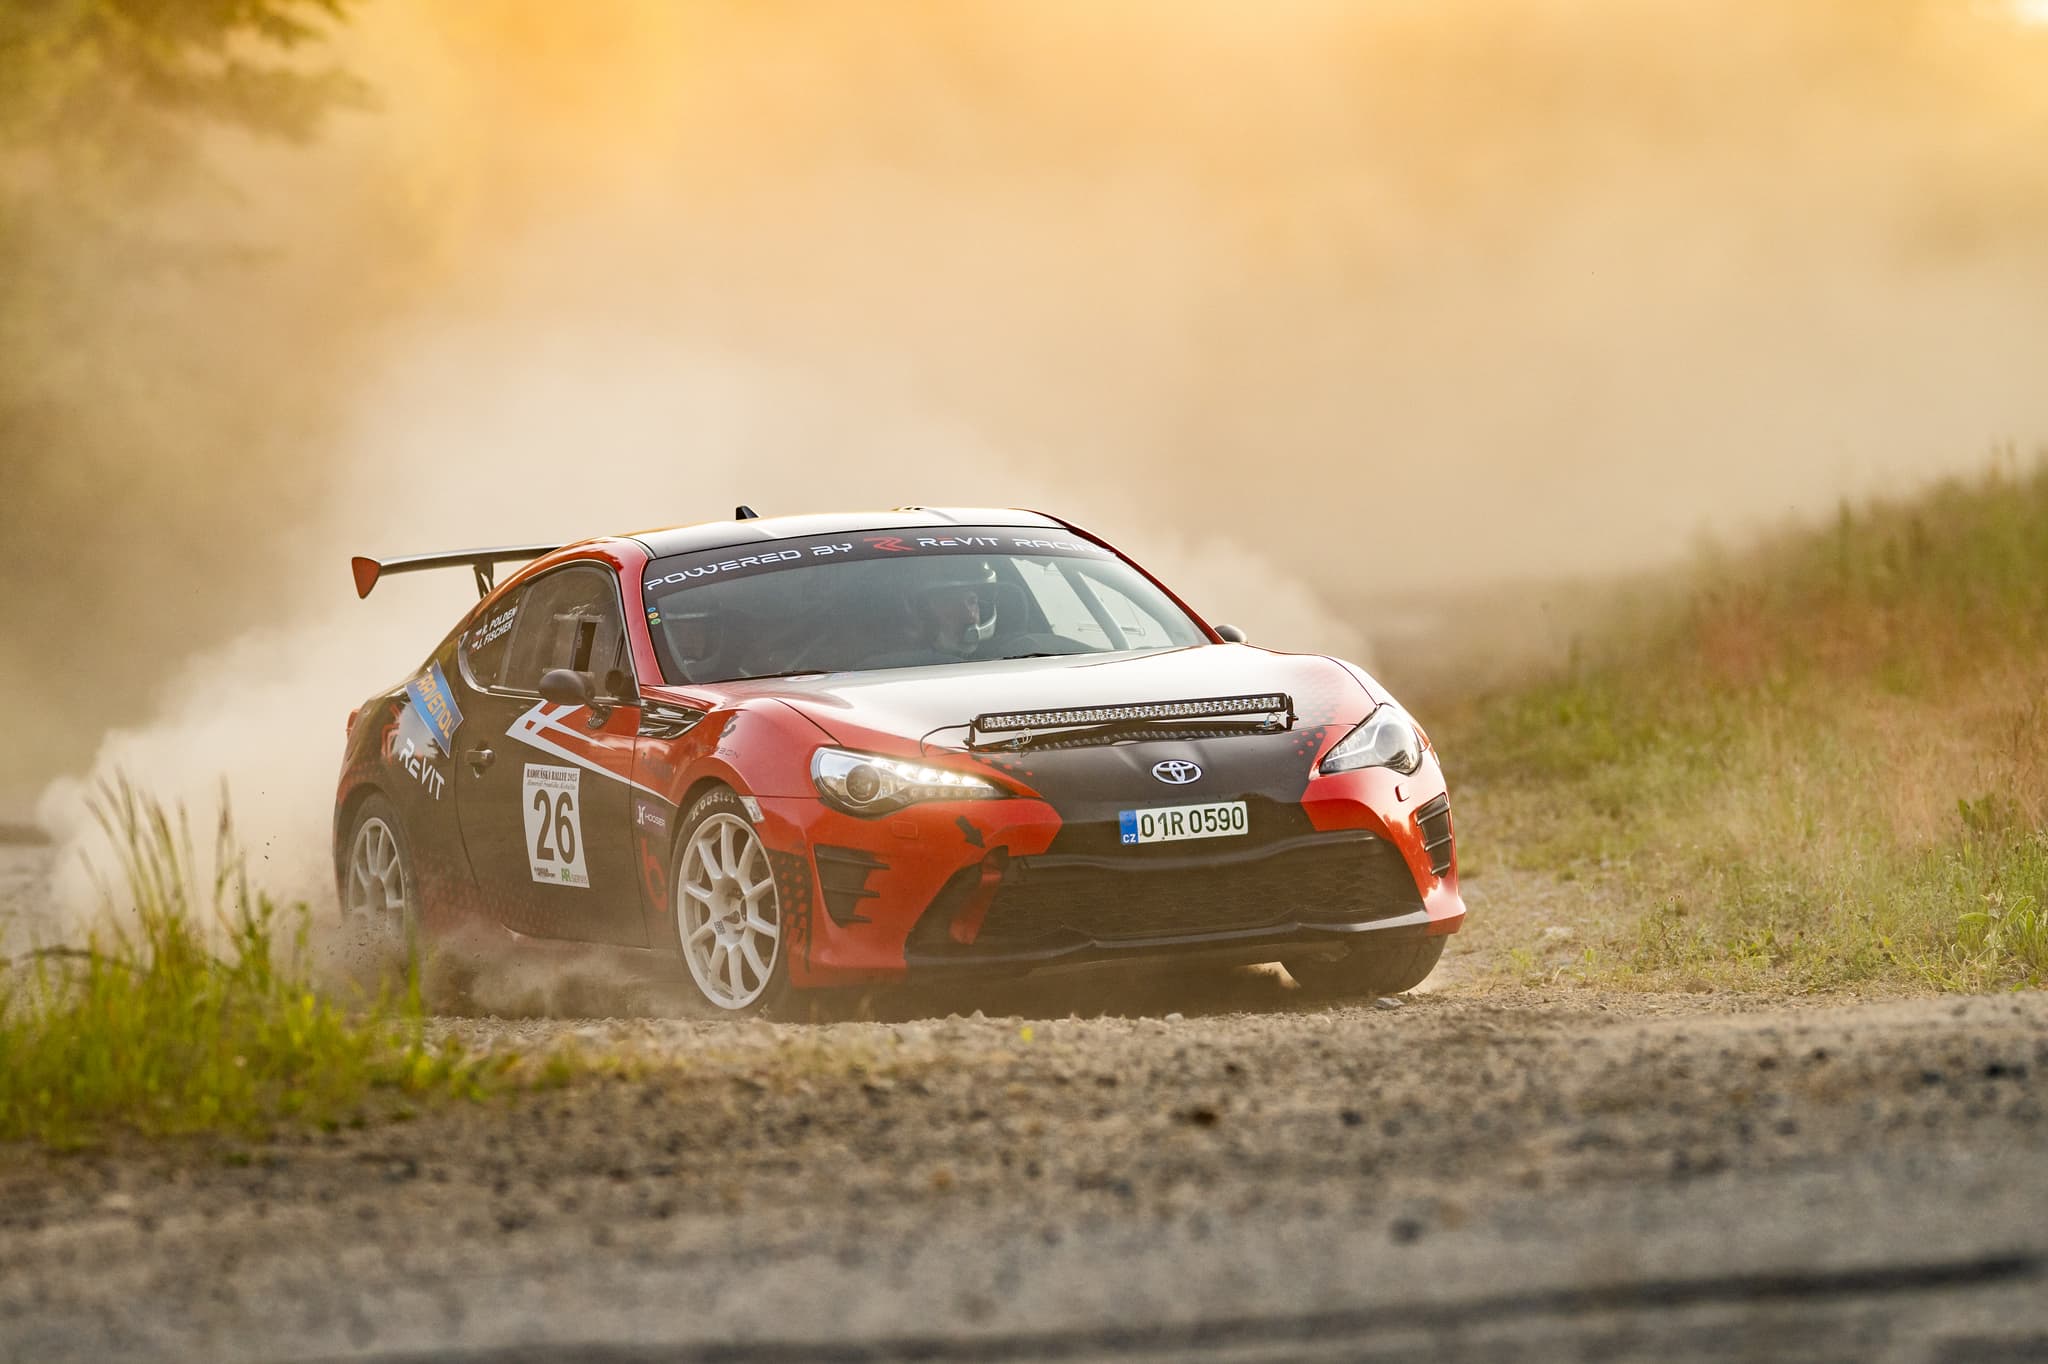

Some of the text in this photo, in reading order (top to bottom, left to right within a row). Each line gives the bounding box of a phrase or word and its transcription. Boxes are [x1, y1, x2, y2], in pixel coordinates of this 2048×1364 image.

[916, 536, 999, 547] REVIT
[645, 543, 853, 591] POWERED BY
[483, 618, 514, 646] FISCHER
[415, 673, 453, 739] RAVENOL
[399, 737, 445, 800] REVIT
[533, 789, 576, 864] 26
[1123, 833, 1137, 843] CZ
[1140, 806, 1244, 837] 01R 0590
